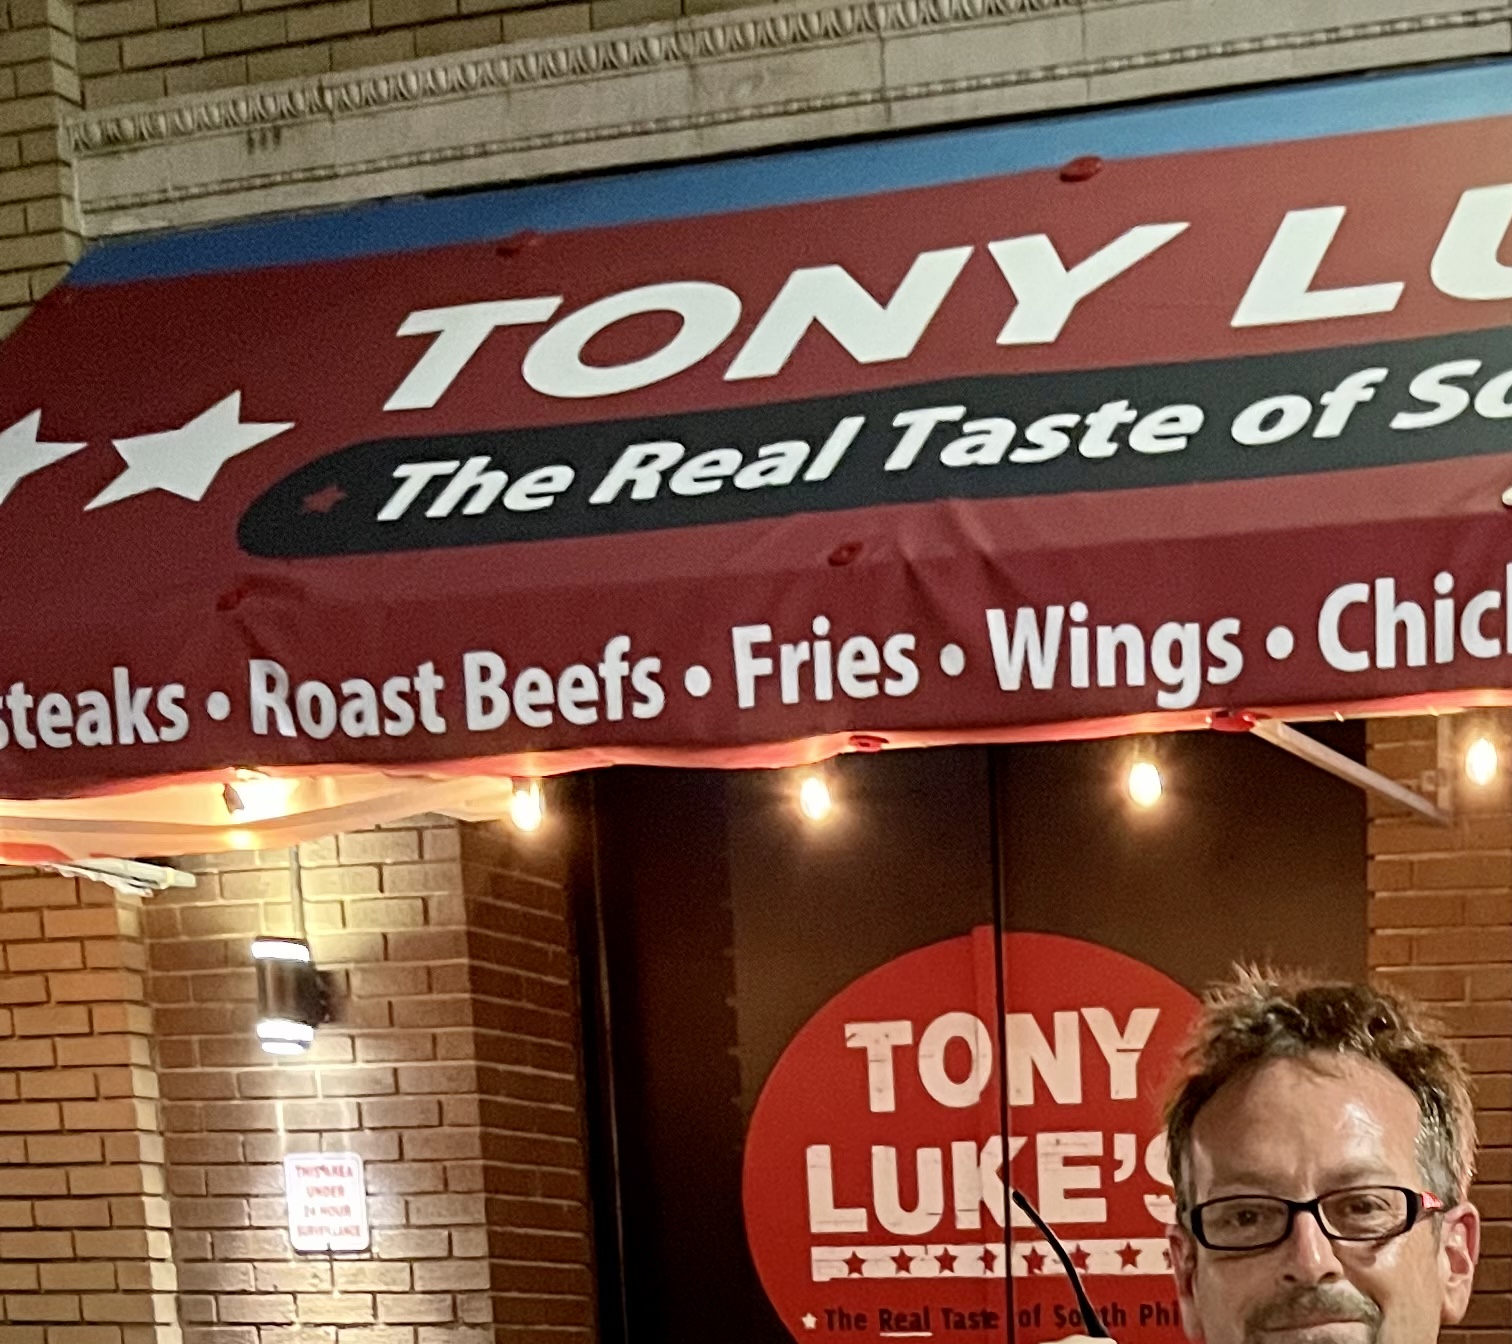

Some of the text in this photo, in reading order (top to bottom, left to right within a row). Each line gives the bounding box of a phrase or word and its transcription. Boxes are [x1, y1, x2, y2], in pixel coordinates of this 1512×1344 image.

[382, 222, 1190, 412] TONY
[377, 456, 575, 521] The
[588, 416, 866, 504] Real
[884, 399, 1205, 471] Taste
[1230, 367, 1389, 445] of
[249, 660, 447, 740] Roast
[462, 636, 666, 731] Beefs
[732, 615, 920, 710] Fries
[986, 600, 1244, 709] Wings
[844, 1007, 1161, 1113] TONY
[824, 1301, 1181, 1331] The Real Taste of Soth Phi
